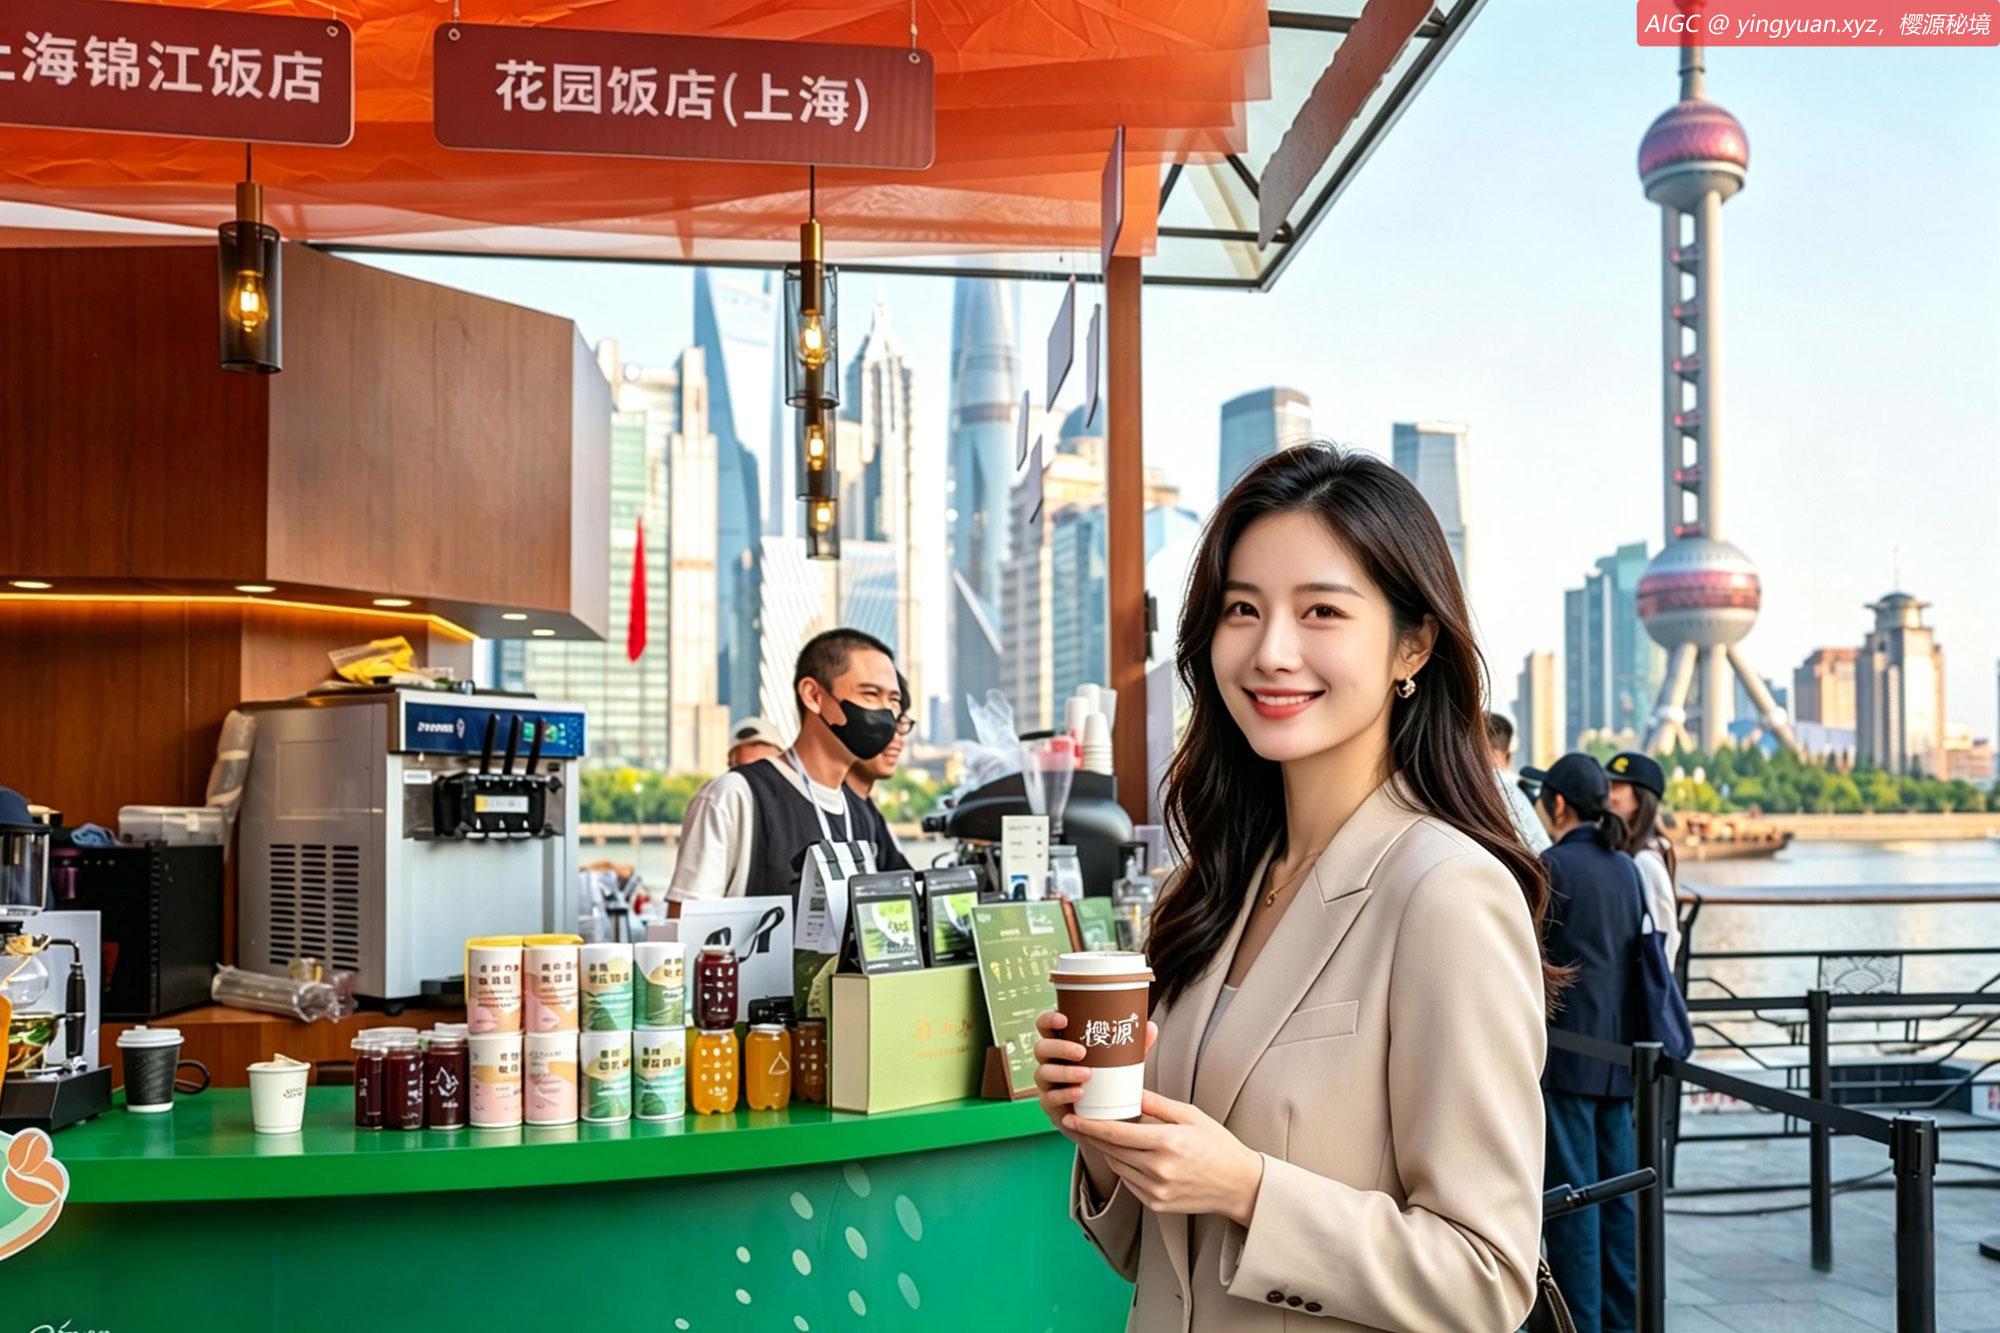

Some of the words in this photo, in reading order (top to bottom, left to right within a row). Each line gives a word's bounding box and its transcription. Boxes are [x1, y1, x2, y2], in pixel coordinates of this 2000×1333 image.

[495, 59, 870, 133] 花园饭店(上海)
